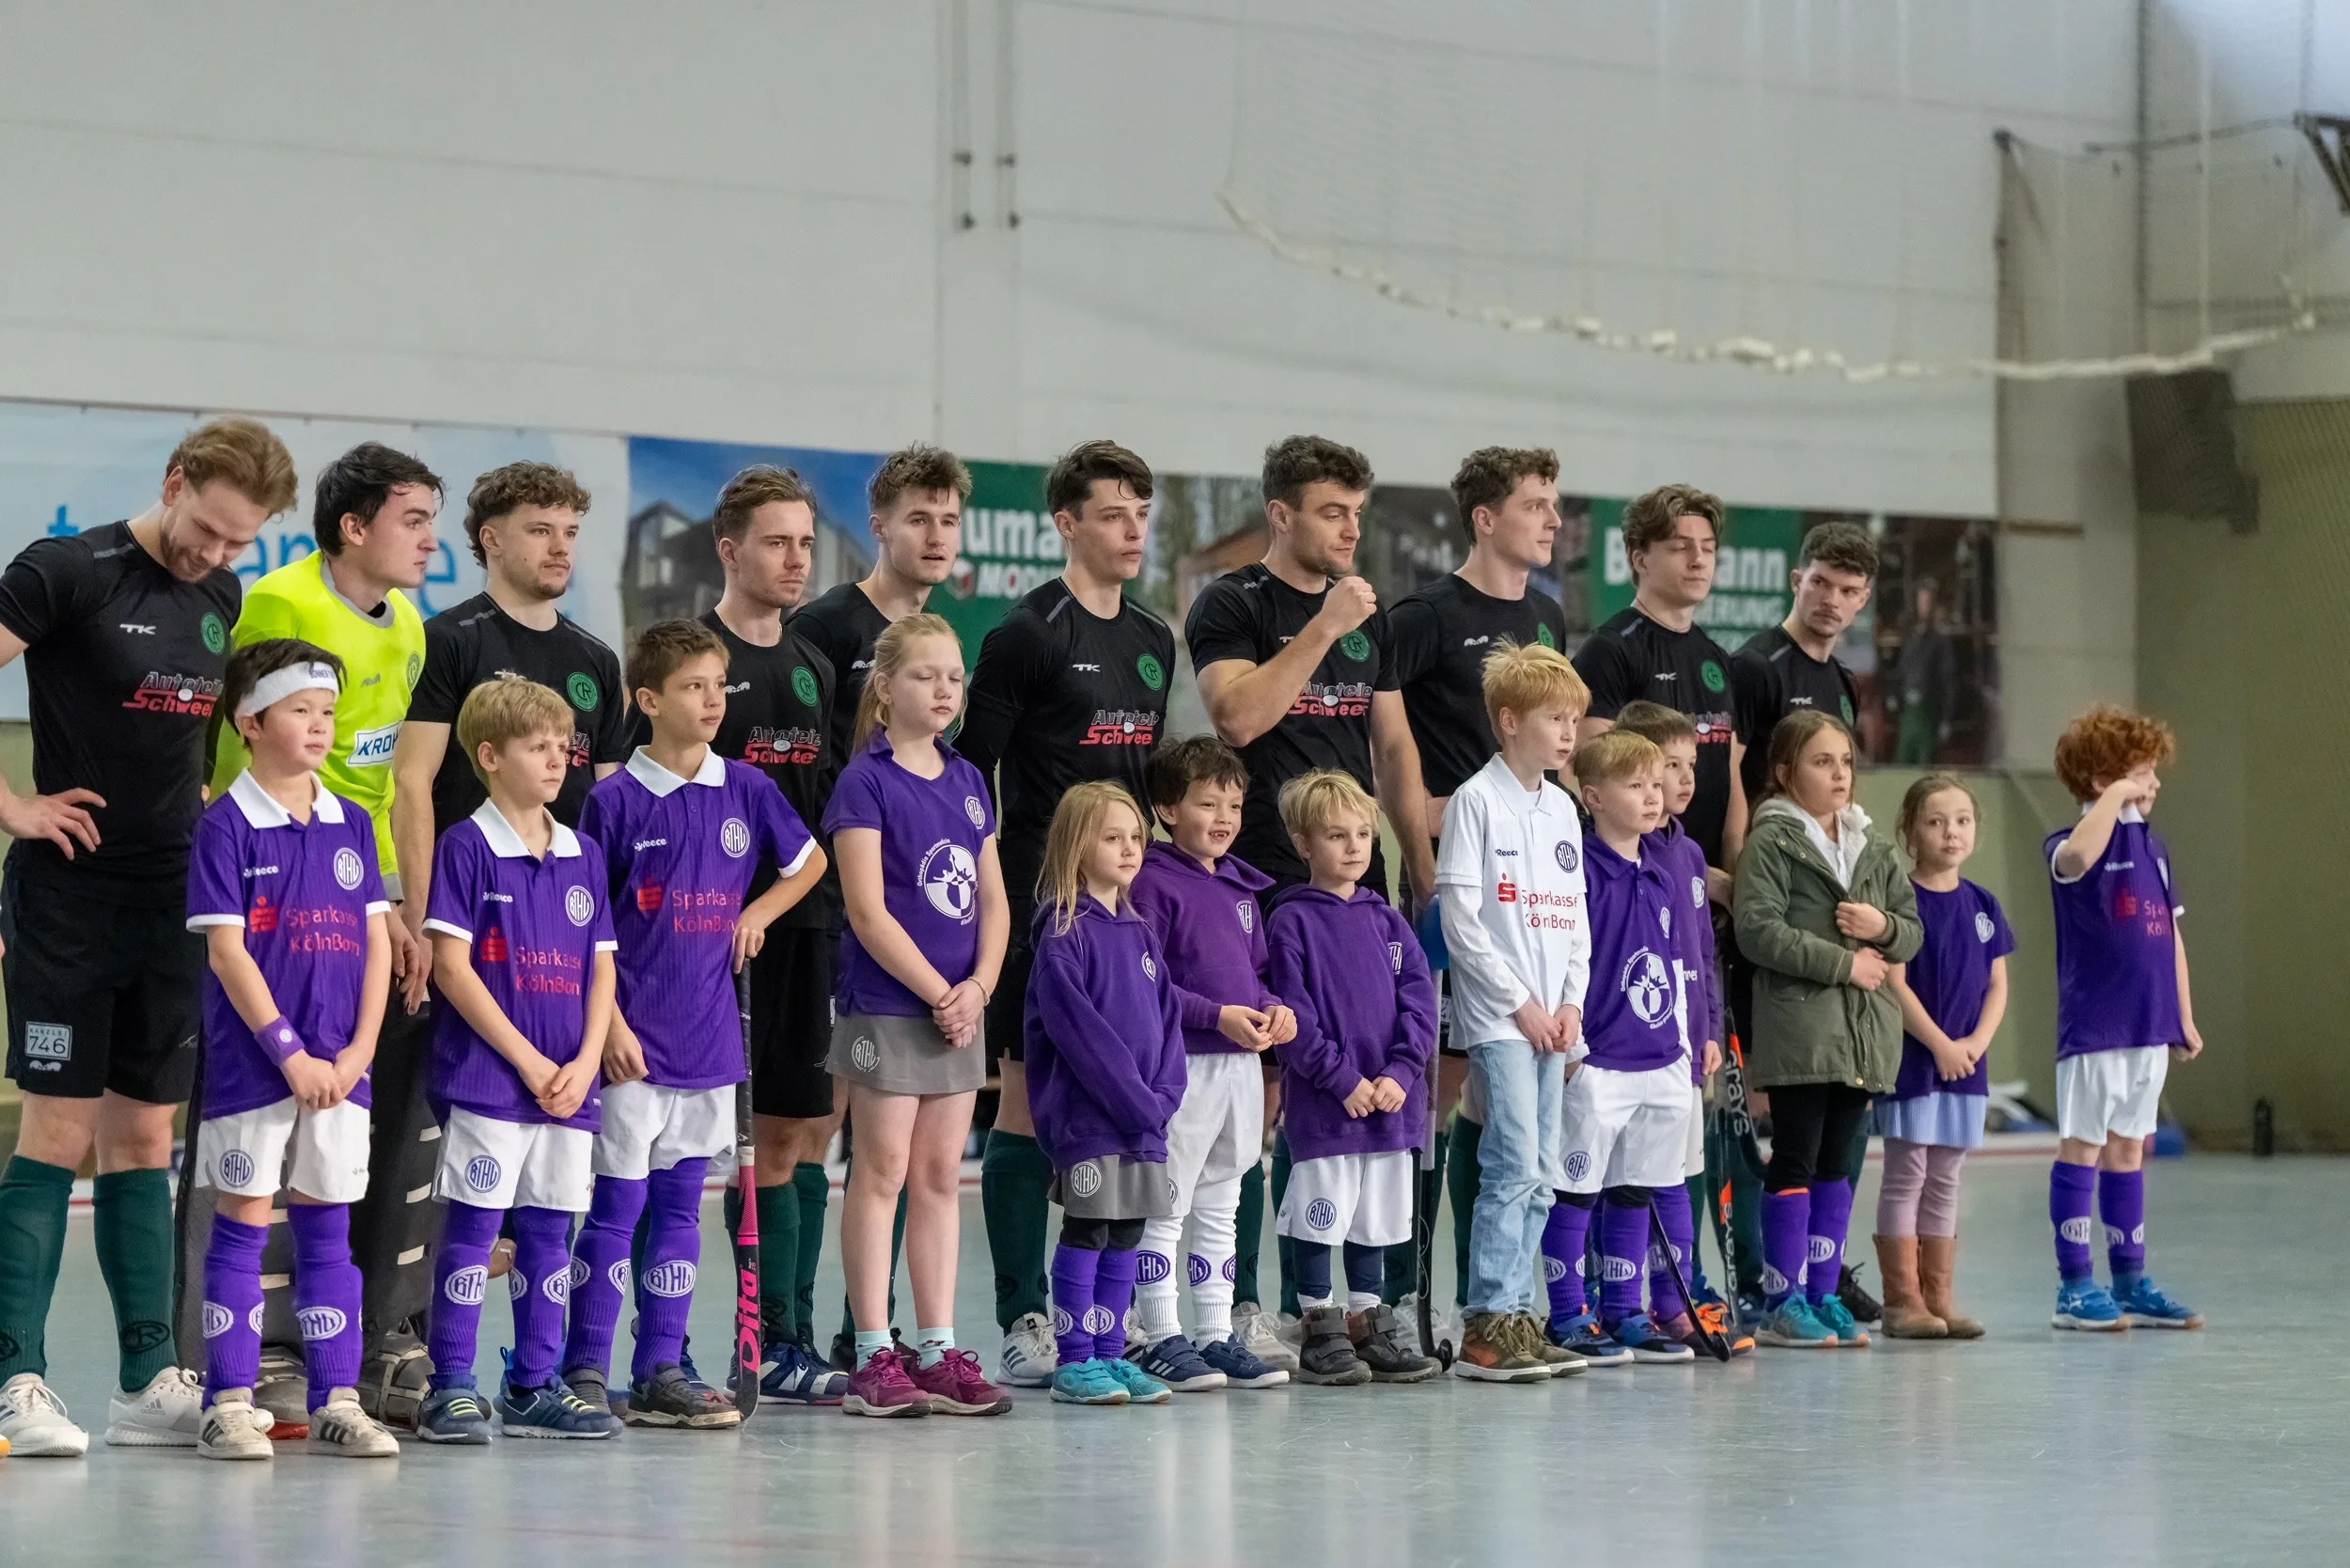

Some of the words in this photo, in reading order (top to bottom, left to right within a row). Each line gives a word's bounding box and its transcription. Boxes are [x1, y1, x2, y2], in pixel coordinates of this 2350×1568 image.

[747, 726, 822, 746] Autoteie
[286, 905, 358, 929] Sparkass
[673, 915, 735, 933] KölnBon
[290, 932, 361, 956] KölnBon
[28, 1035, 66, 1055] 746
[738, 1268, 760, 1384] Dita
